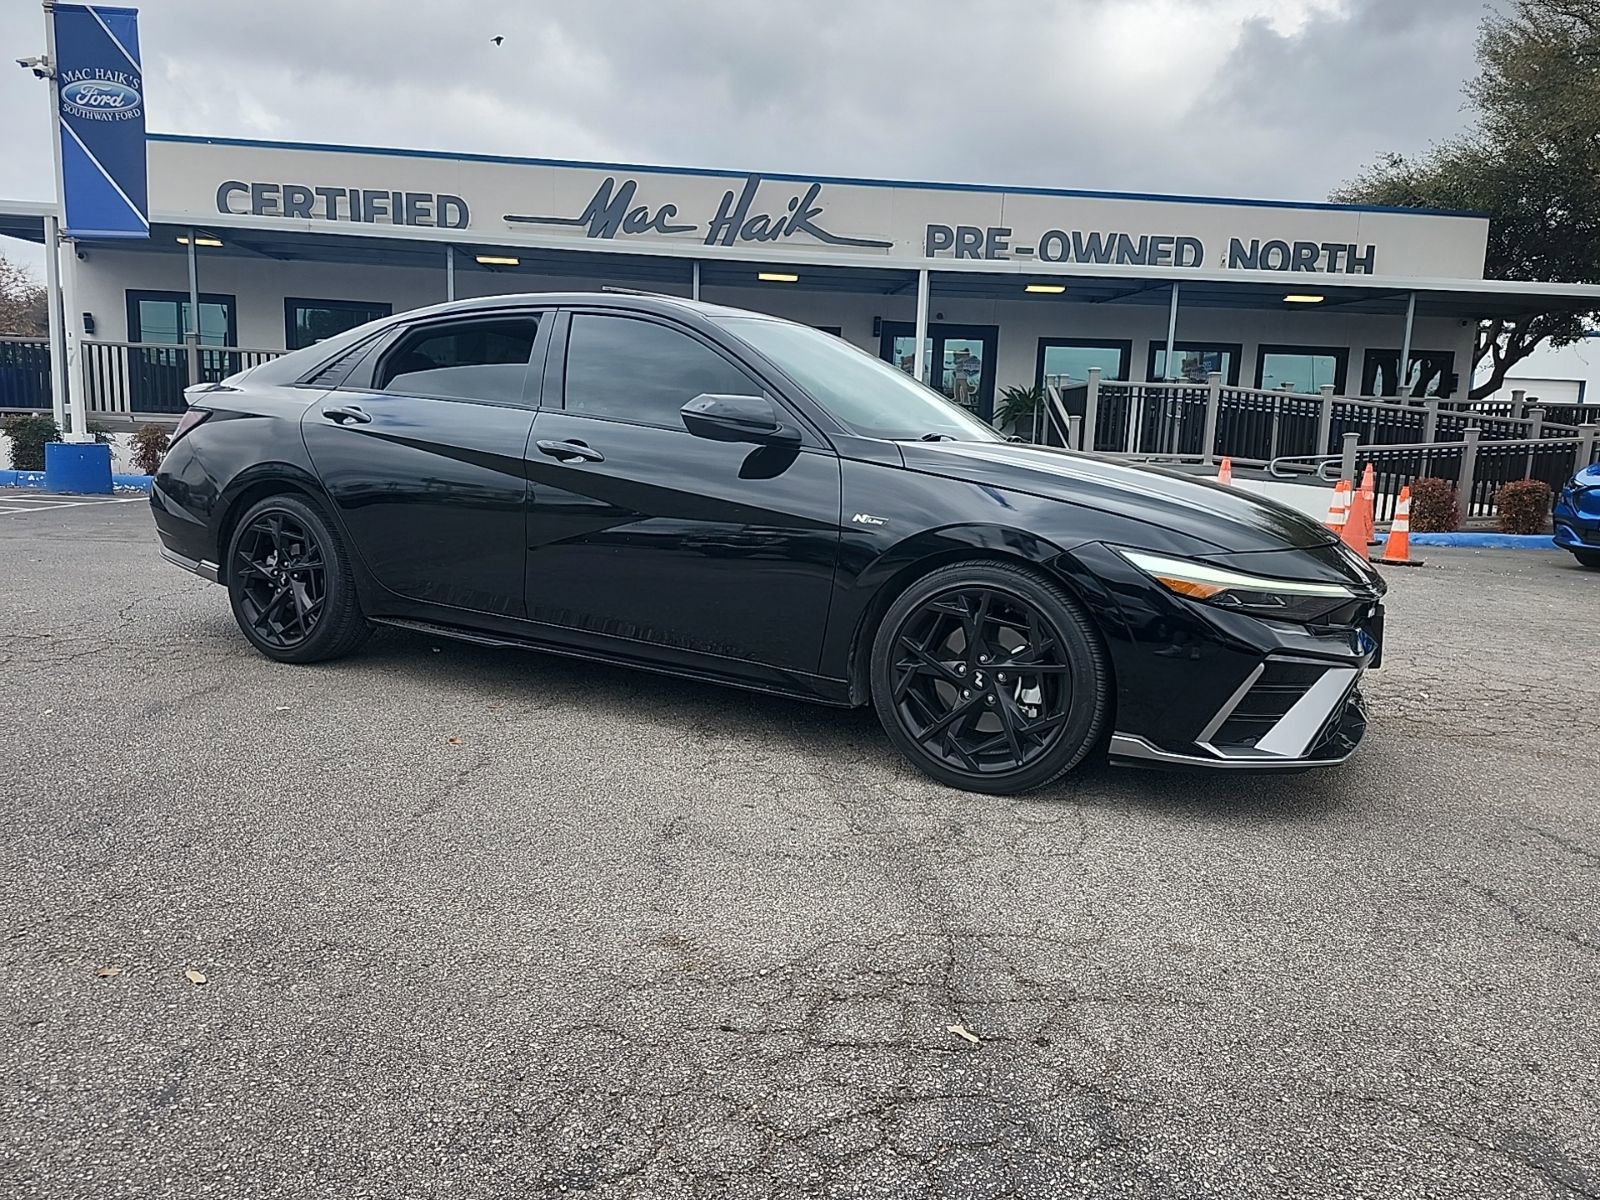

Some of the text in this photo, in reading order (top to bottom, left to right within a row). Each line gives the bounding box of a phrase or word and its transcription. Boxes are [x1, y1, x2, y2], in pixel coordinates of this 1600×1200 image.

[61, 68, 140, 89] MAC HAIK'S
[76, 84, 124, 107] Ford
[62, 103, 141, 121] SOUTHWAY FORD
[215, 180, 471, 230] CERTIFIED
[503, 174, 893, 247] Mac Haik
[925, 224, 1376, 275] PRE-OWNED NORTH
